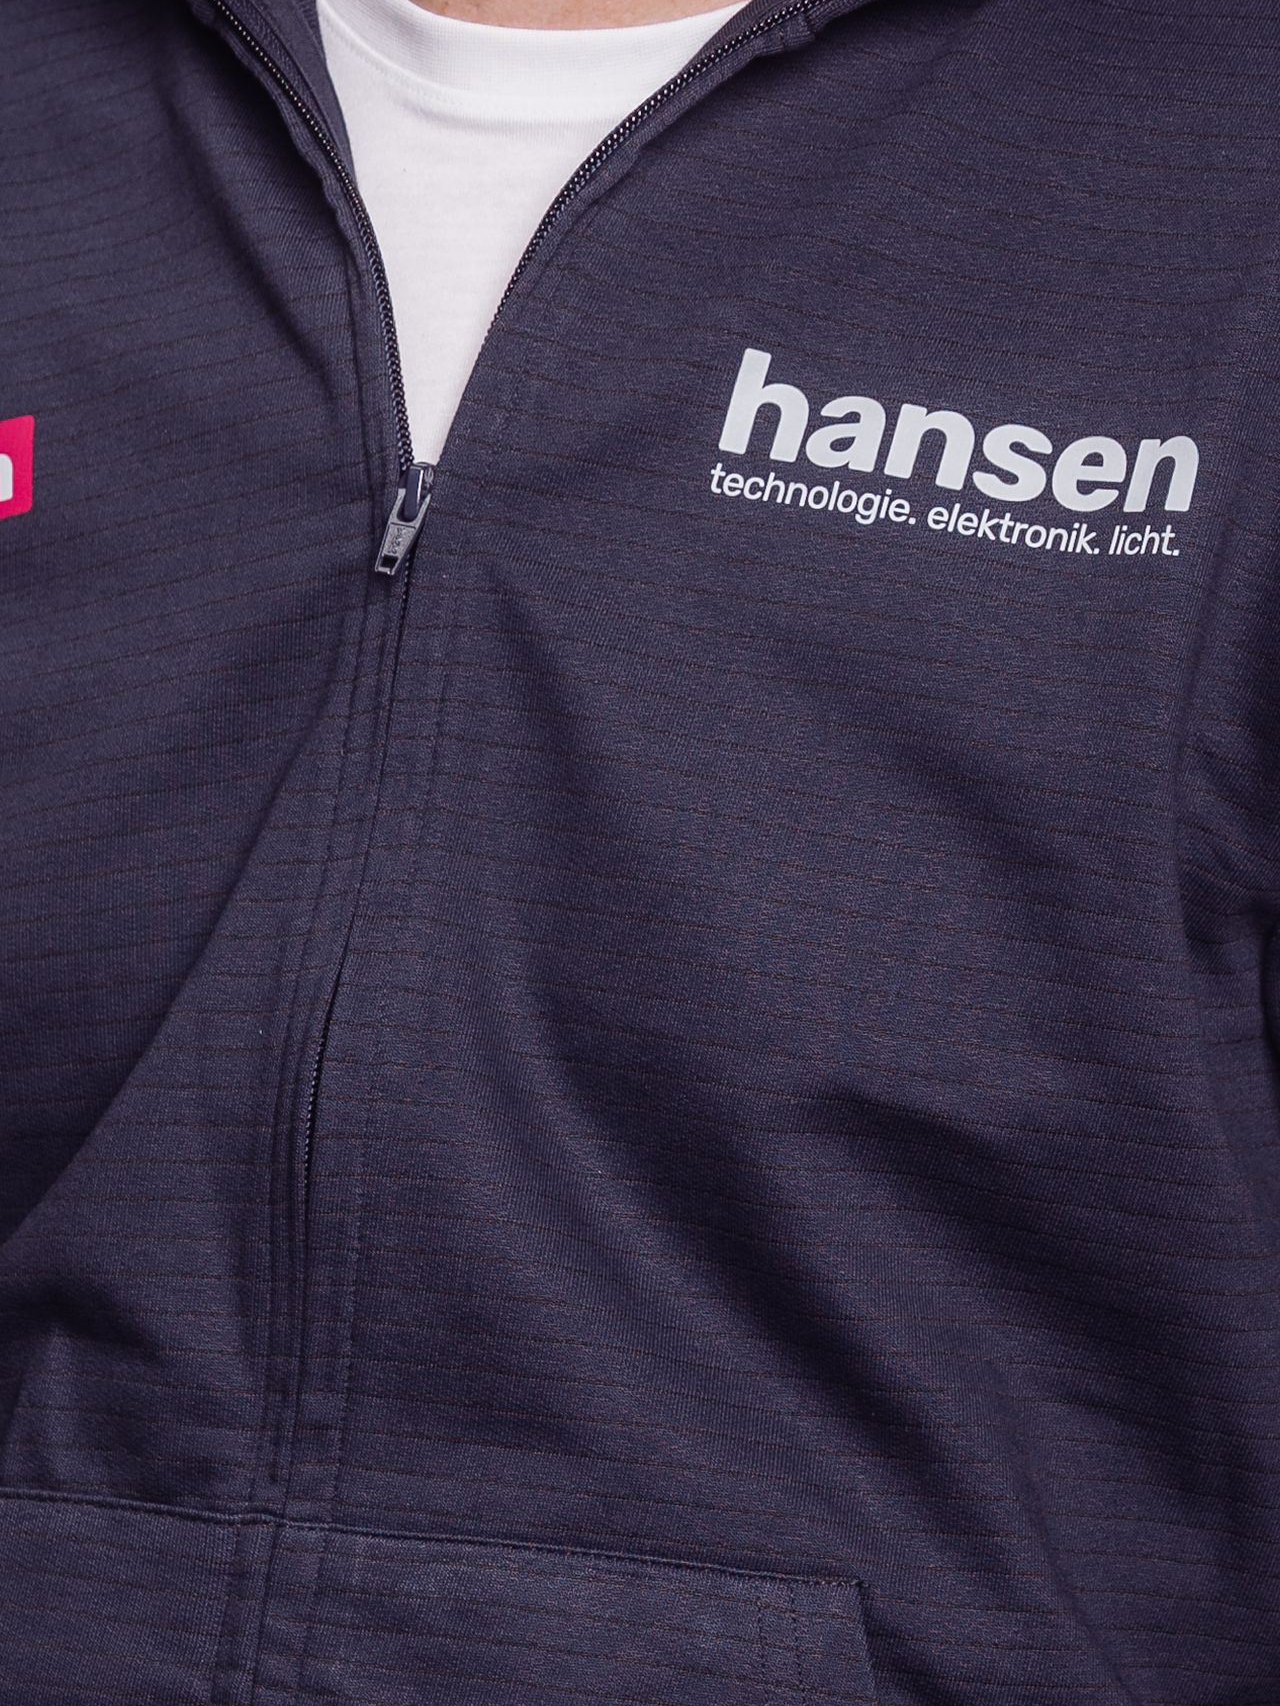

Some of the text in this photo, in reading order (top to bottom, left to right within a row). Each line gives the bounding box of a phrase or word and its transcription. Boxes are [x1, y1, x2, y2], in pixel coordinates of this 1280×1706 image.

[718, 347, 1200, 513] hansen
[710, 462, 1180, 557] technologie. elektronik. licht.
